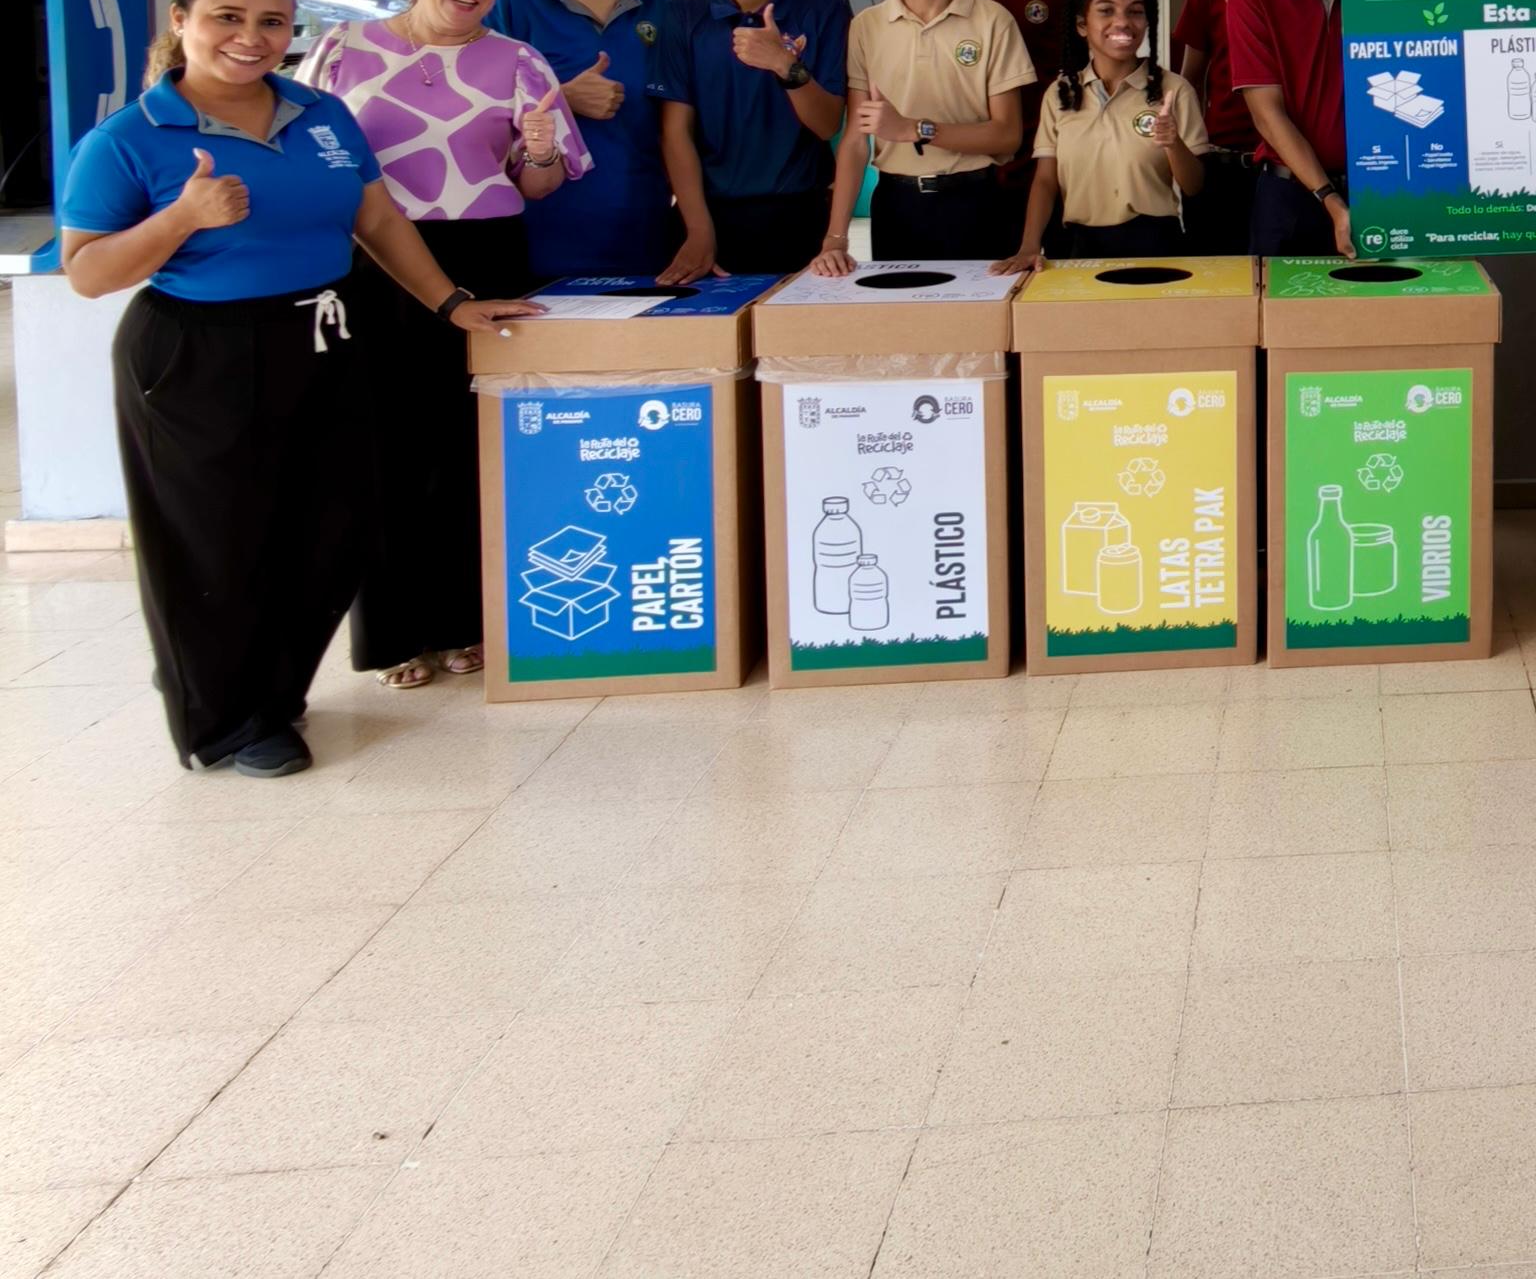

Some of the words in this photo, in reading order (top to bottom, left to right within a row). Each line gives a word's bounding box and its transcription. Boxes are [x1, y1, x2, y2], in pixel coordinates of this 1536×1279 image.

[1483, 3, 1530, 22] Esta
[1350, 41, 1391, 60] PAPEL
[1393, 40, 1403, 58] Y
[1405, 36, 1458, 58] CARTÓN
[1430, 143, 1444, 152] No
[1446, 205, 1472, 216] Todo
[1474, 204, 1485, 214] lo
[1389, 227, 1409, 235] duce
[1502, 229, 1523, 241] hay
[1366, 233, 1383, 245] re
[1434, 391, 1462, 405] CERO
[545, 410, 591, 420] ALCALDÍA
[672, 408, 702, 421] CERO
[825, 405, 866, 414] ALCALDÍA
[944, 401, 973, 416] CERO
[580, 446, 640, 462] Reciclaje
[857, 440, 914, 455] Reciclaje
[1193, 487, 1225, 534] PAK
[930, 511, 967, 620] PLÁSTICO
[1421, 514, 1452, 604] VIDRIOS
[1158, 537, 1191, 610] LATAS
[1193, 538, 1225, 609] TETRA
[663, 537, 704, 630] CARTÓN
[631, 556, 666, 632] PAPEL
